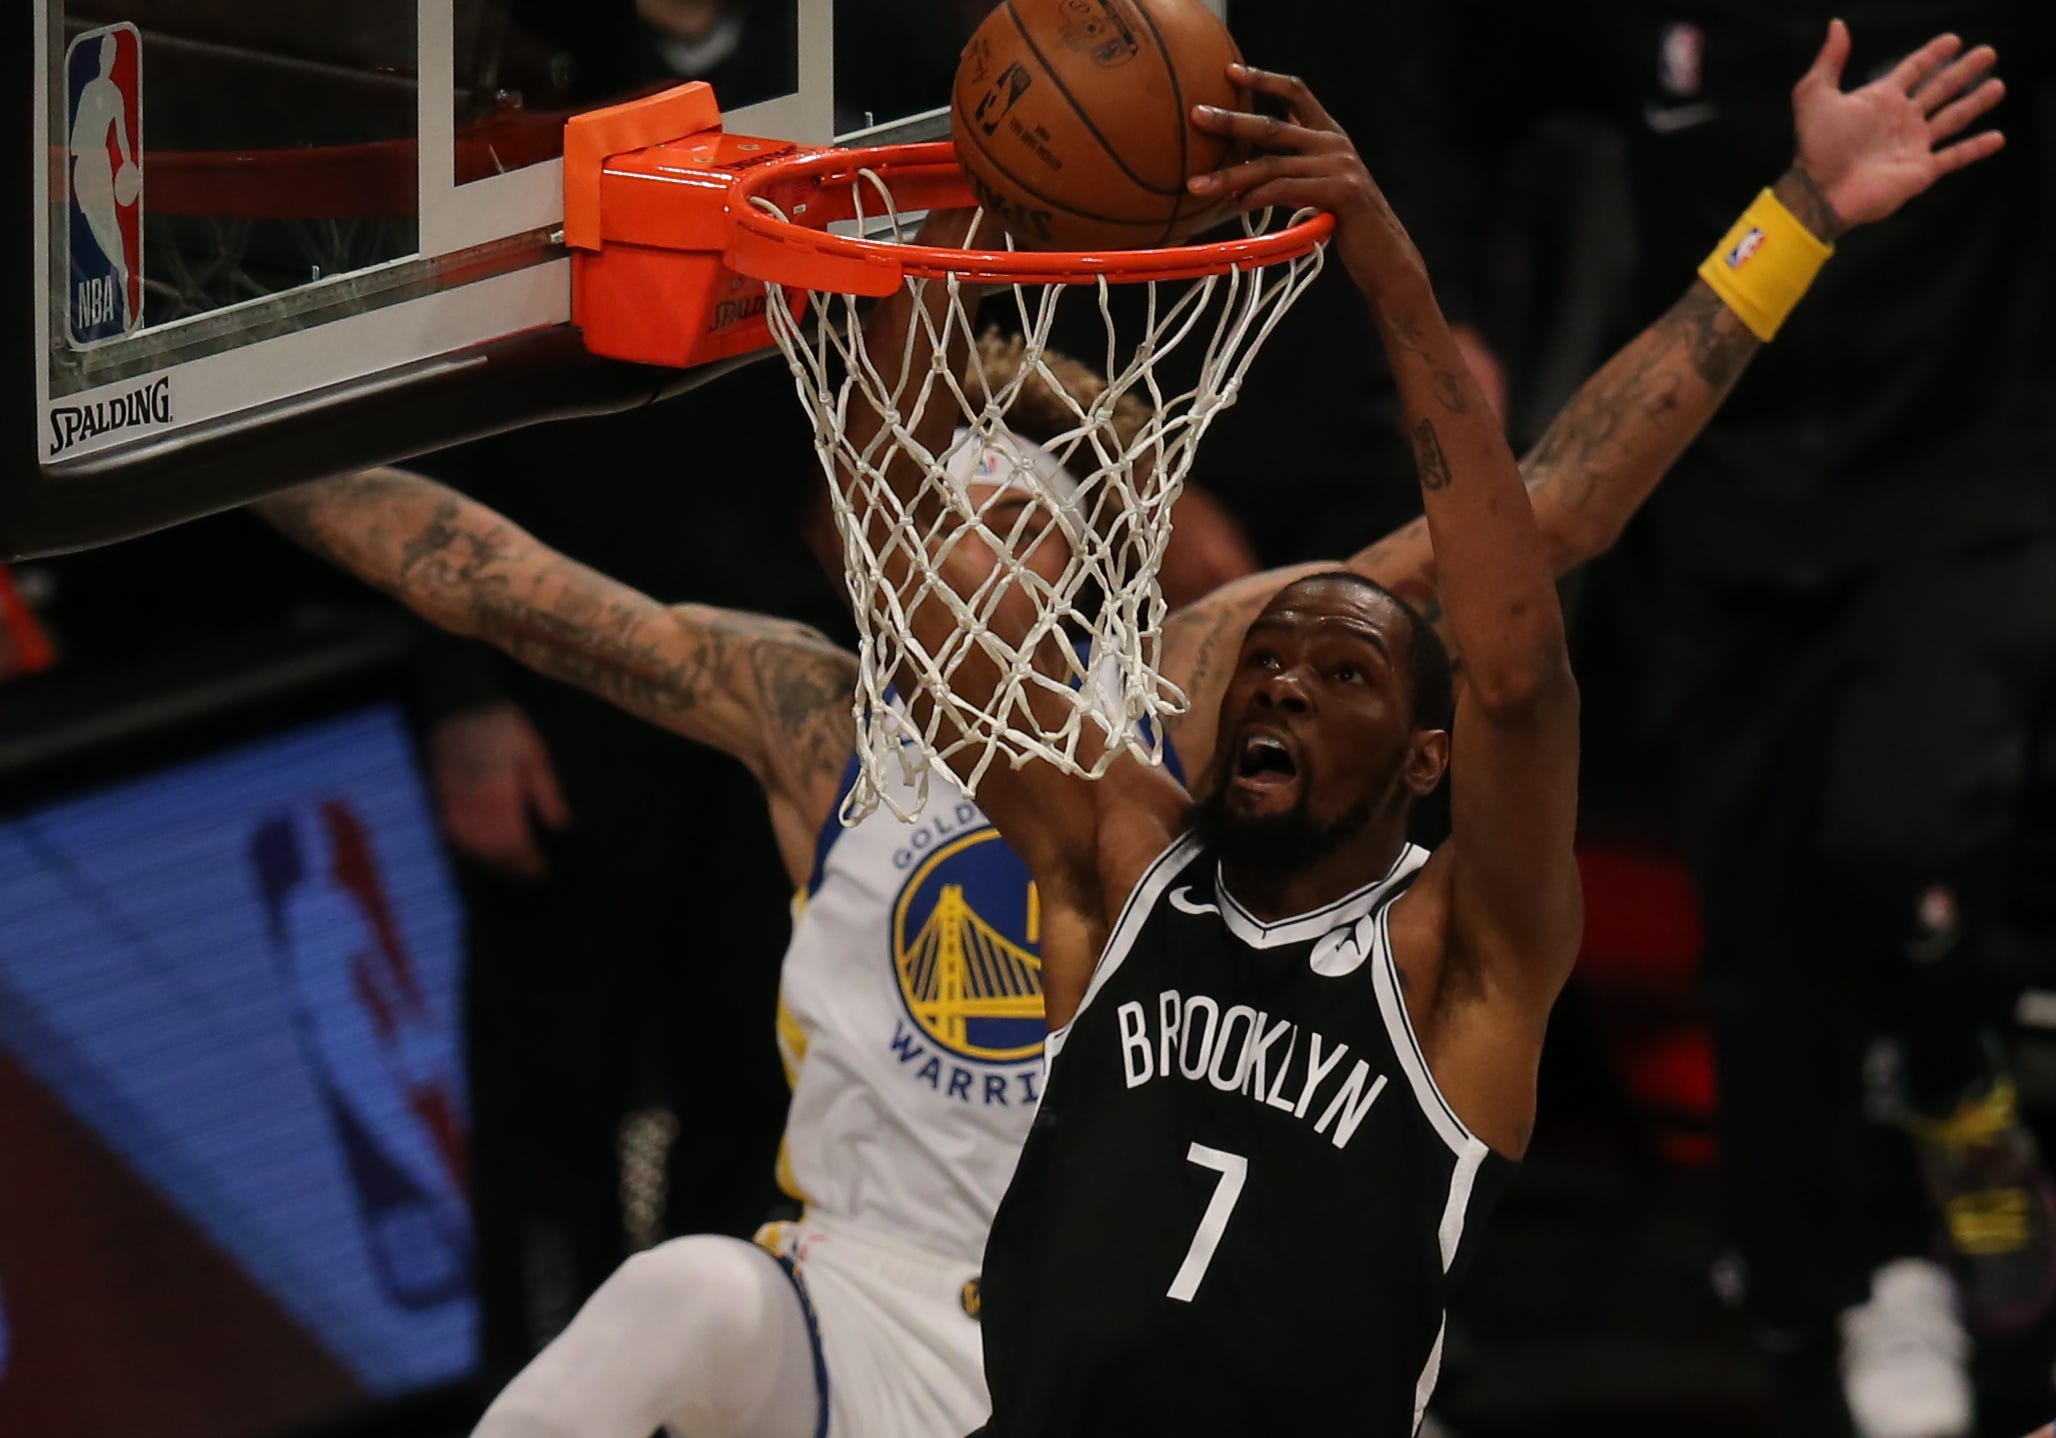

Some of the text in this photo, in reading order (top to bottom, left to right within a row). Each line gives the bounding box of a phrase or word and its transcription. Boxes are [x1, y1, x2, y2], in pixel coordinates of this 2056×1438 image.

[78, 275, 115, 329] NBA
[50, 376, 170, 456] SPALDING
[893, 802, 975, 869] GOLD
[891, 1021, 1039, 1106] WARRI
[1117, 989, 1388, 1149] BROOKLYN
[1166, 1141, 1249, 1302] 7
